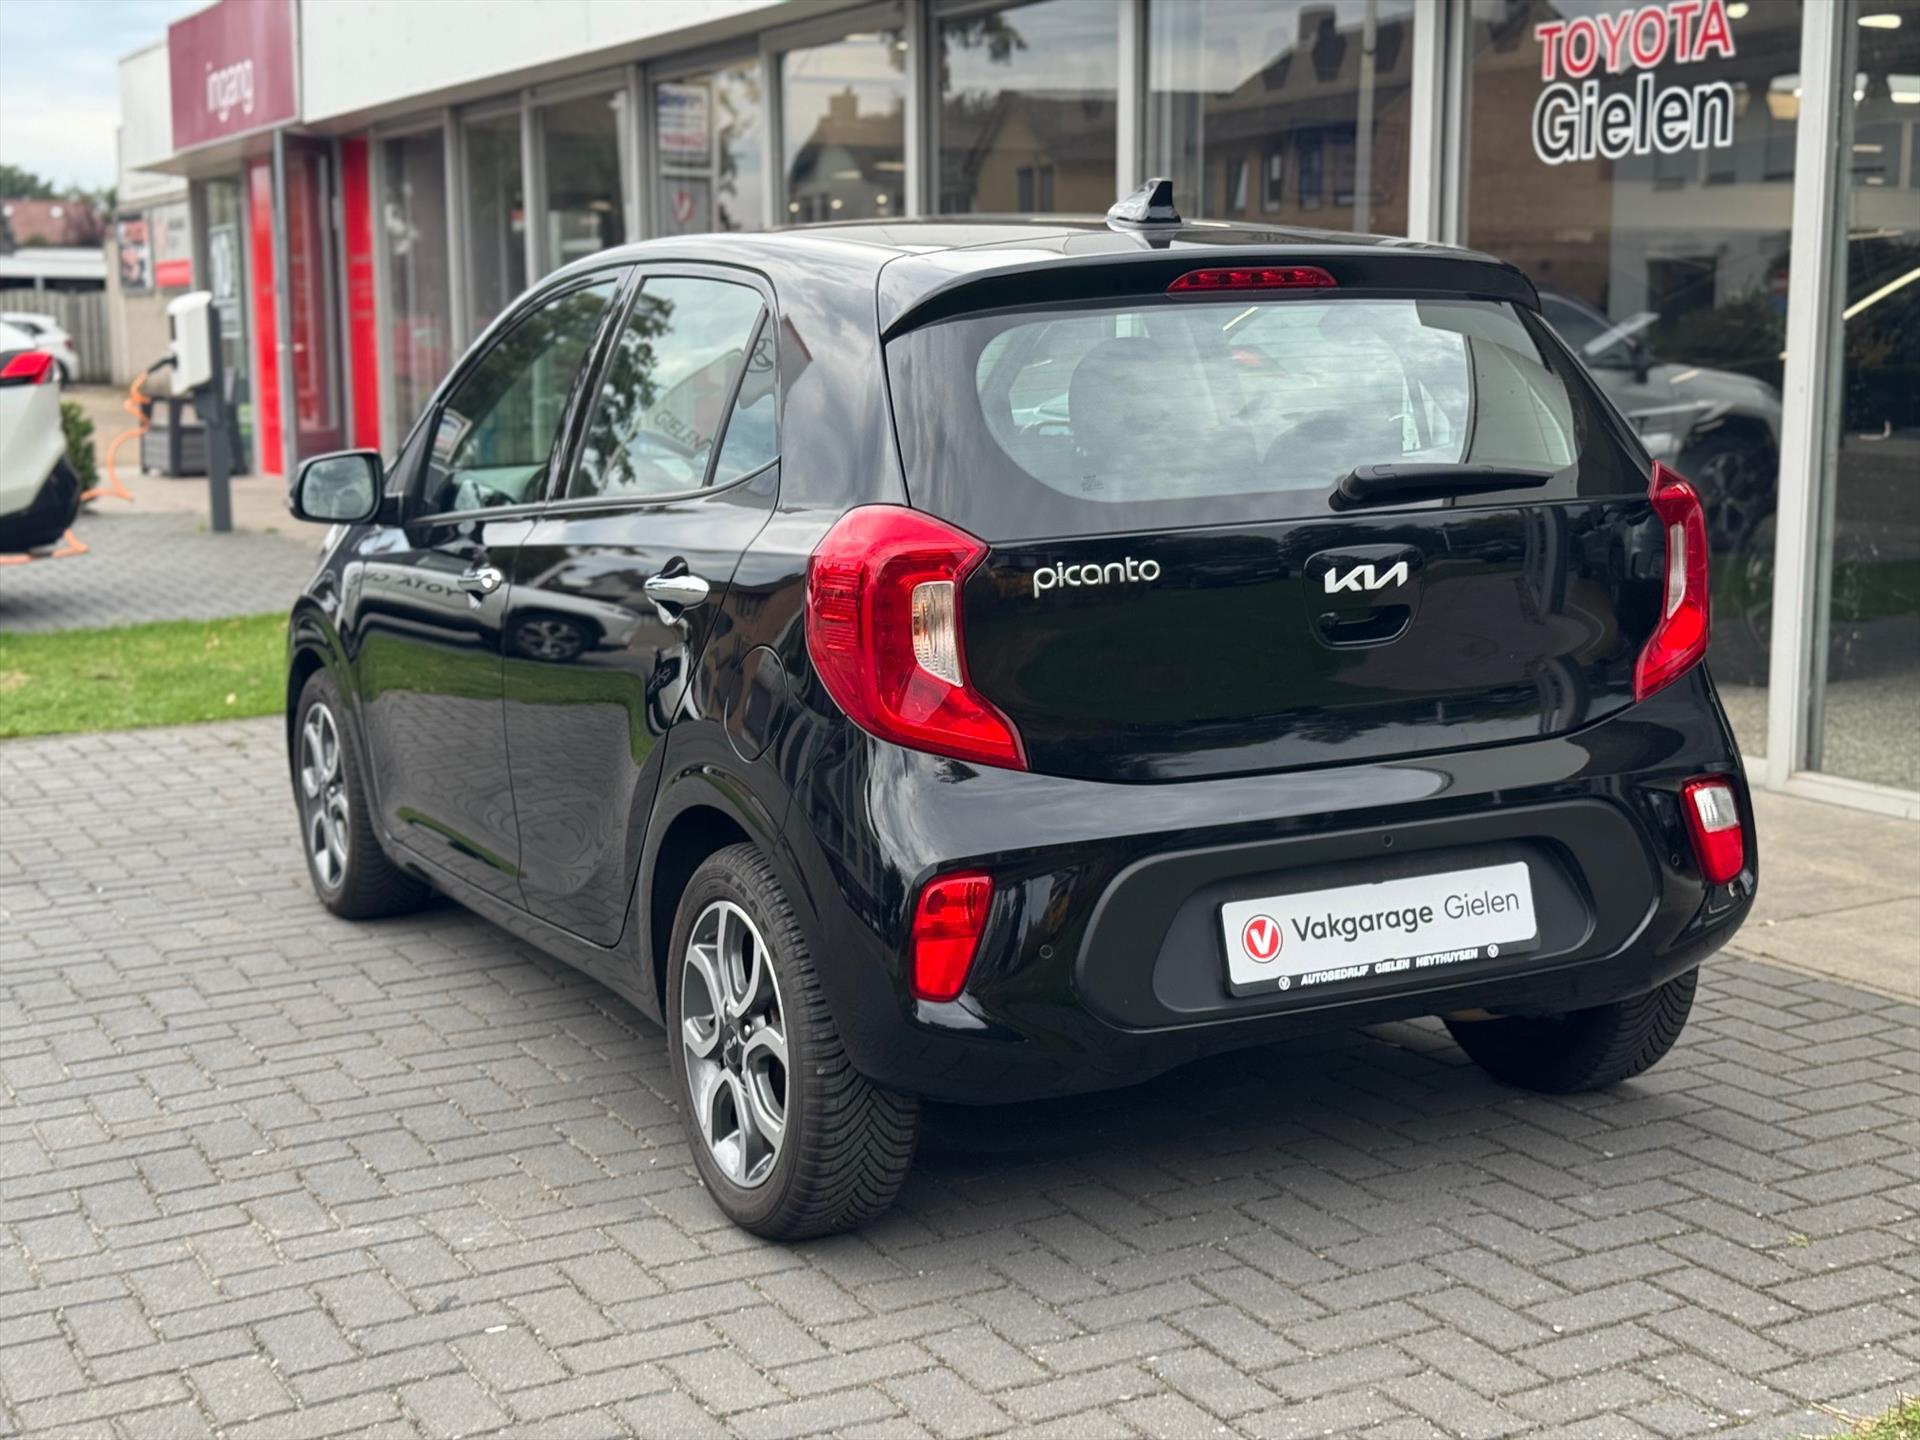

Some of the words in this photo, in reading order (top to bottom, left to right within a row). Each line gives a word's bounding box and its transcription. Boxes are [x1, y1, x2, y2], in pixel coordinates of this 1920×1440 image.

[1534, 0, 1736, 81] TOYOTA
[206, 60, 254, 123] ingang
[1532, 72, 1734, 165] Gielen
[1033, 556, 1161, 599] picanto
[1324, 561, 1408, 594] KIA
[1292, 906, 1433, 942] Vakgarage
[1444, 890, 1520, 919] Gielen
[1300, 965, 1370, 986] AUTOBEDRIJF
[1375, 958, 1411, 974] GIELEN
[1415, 948, 1479, 968] HEYTHUYSEN
